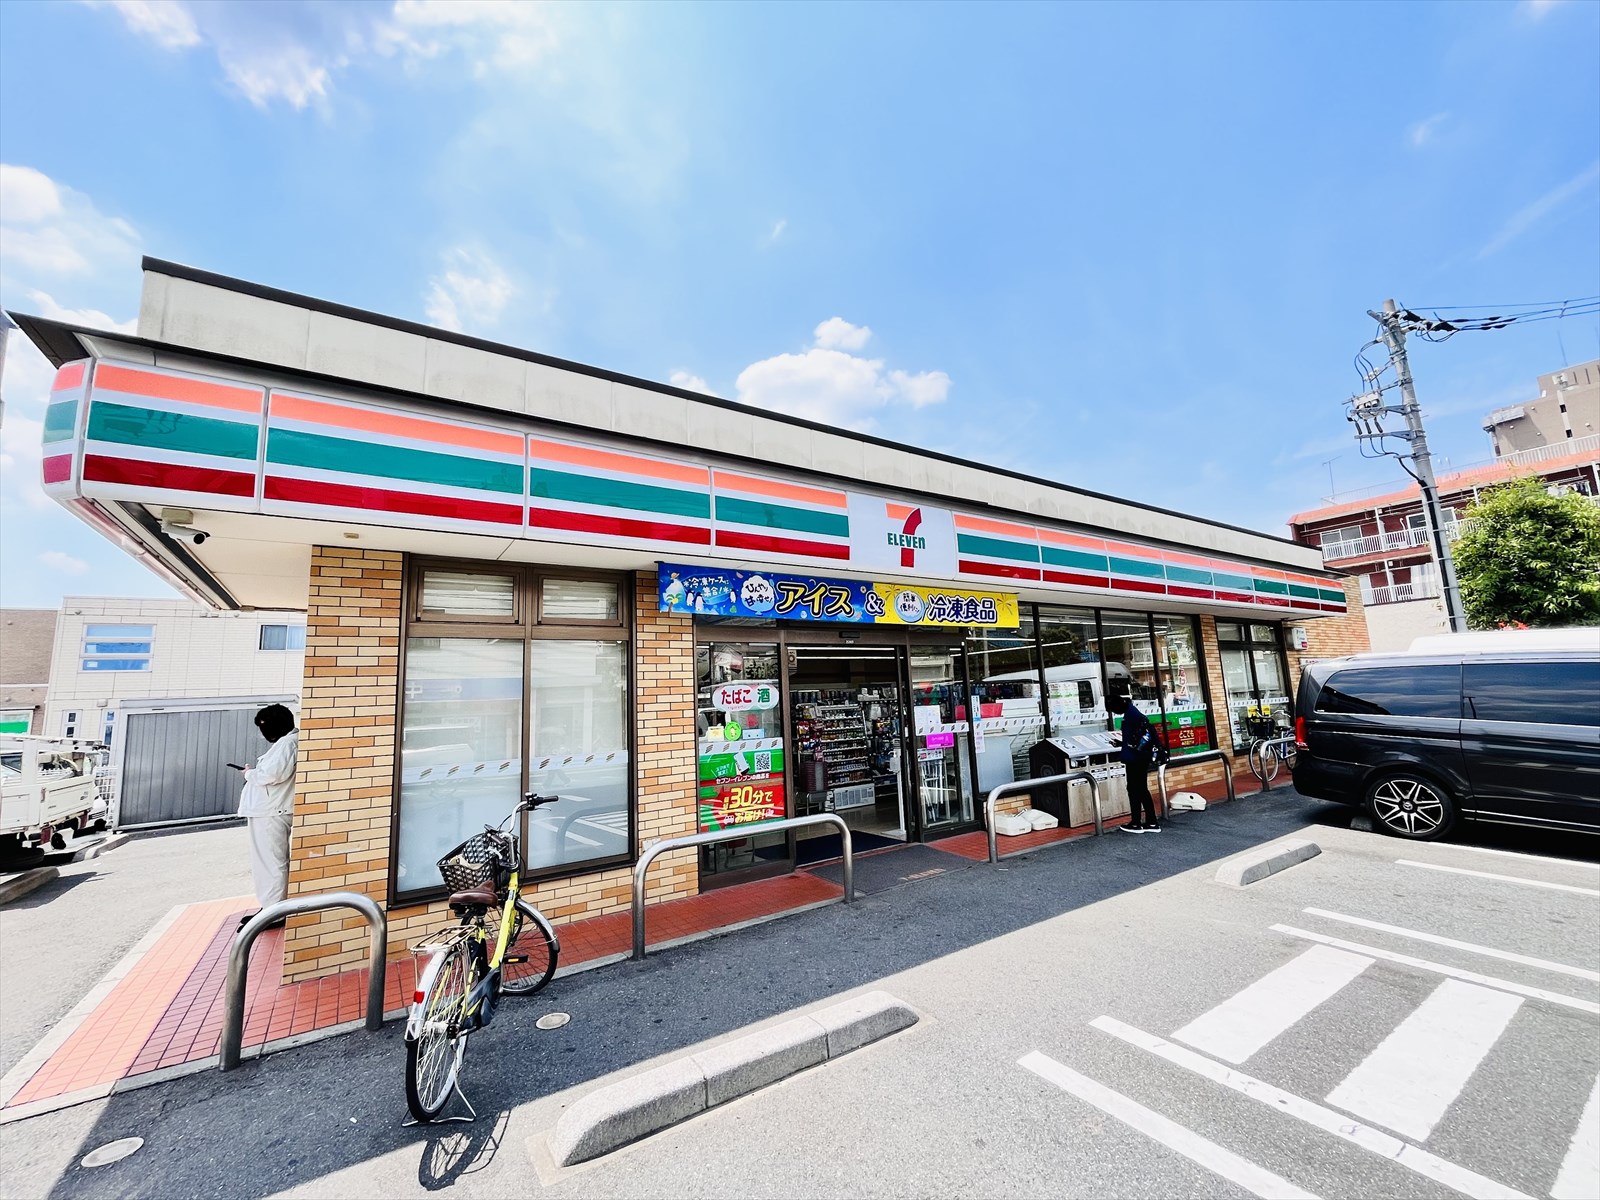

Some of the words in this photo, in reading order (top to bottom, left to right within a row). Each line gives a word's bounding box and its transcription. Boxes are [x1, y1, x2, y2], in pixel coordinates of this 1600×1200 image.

[775, 582, 854, 618] アイス
[865, 591, 885, 616] &
[927, 595, 998, 623] 冷凍食品
[721, 689, 752, 705] たばこ
[757, 688, 770, 703] 酒
